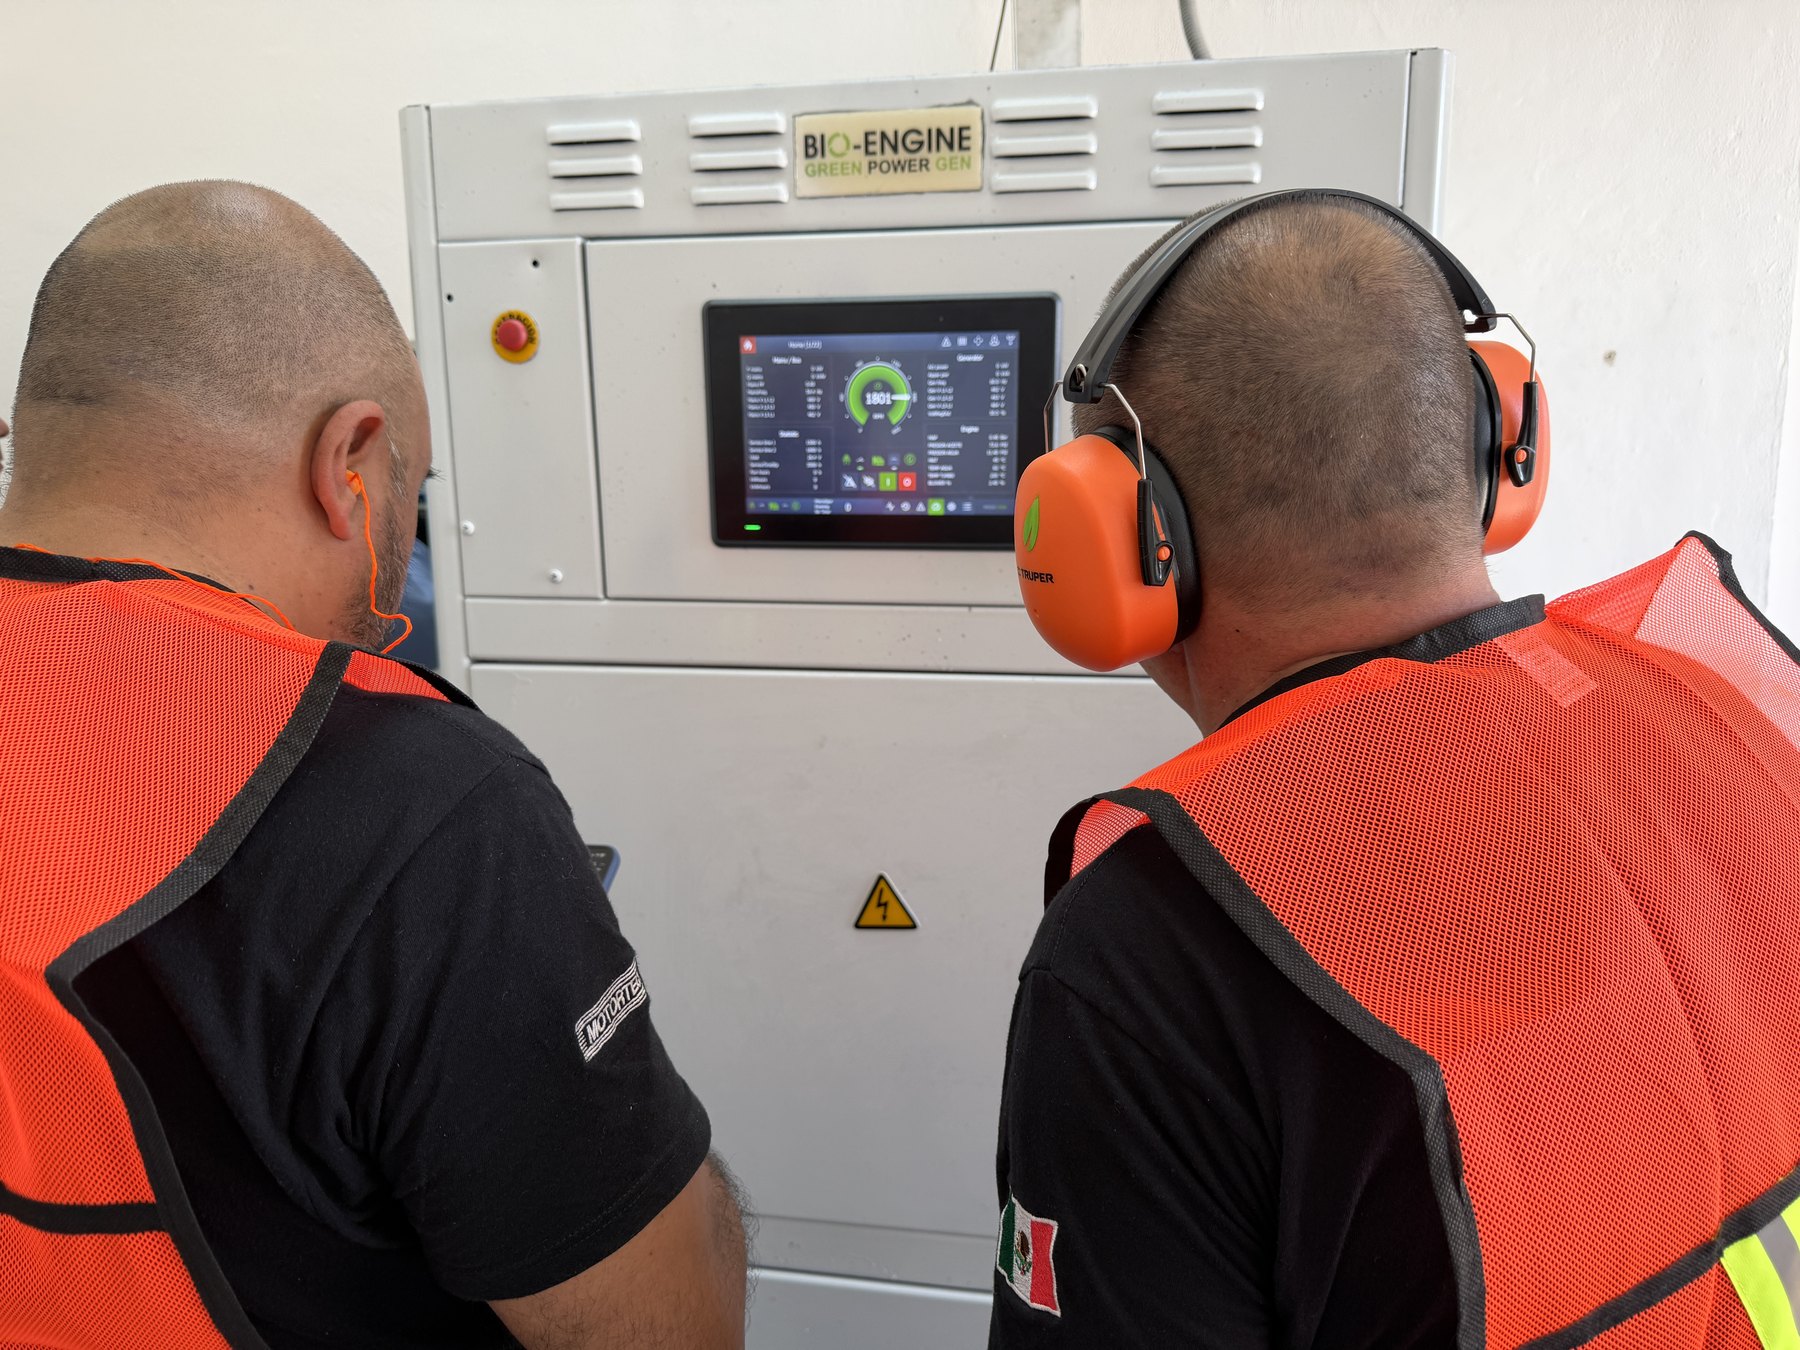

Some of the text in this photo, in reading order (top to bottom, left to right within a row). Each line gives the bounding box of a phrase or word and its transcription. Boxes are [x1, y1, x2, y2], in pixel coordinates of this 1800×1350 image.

[804, 126, 972, 159] BIO-ENGINE
[805, 155, 972, 178] GREEN POWER GEN
[1021, 568, 1054, 583] TRUPER
